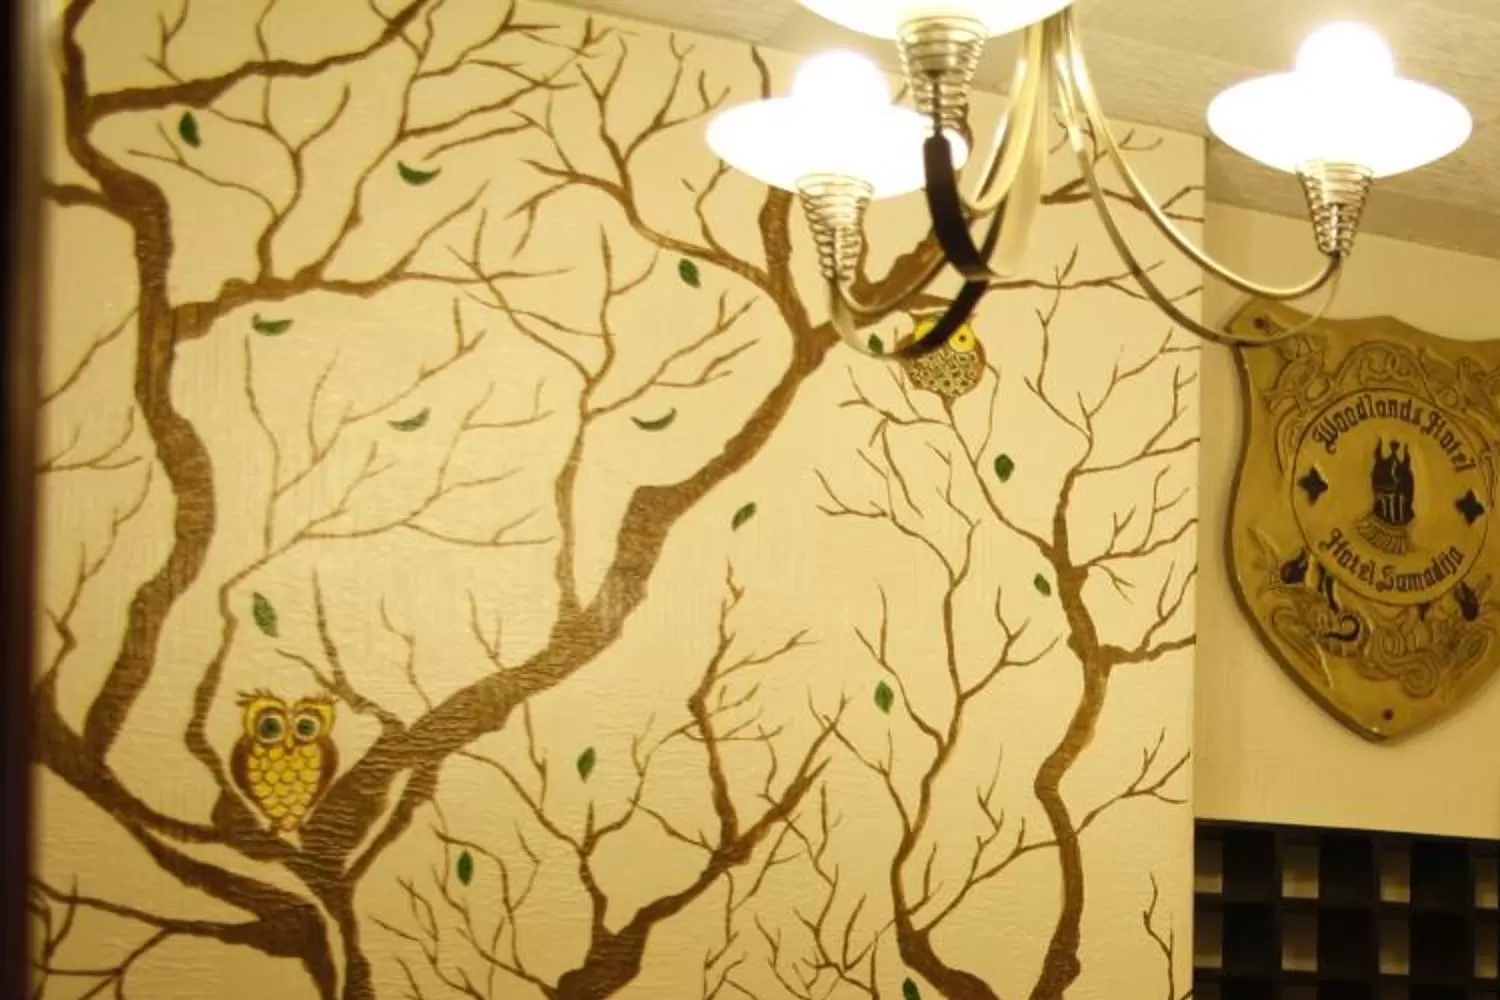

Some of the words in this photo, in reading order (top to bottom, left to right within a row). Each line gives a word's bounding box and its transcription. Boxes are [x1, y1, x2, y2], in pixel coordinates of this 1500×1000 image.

[1311, 393, 1425, 455] Woodlands
[1418, 411, 1477, 473] Hotel
[1318, 527, 1376, 585] Hotel
